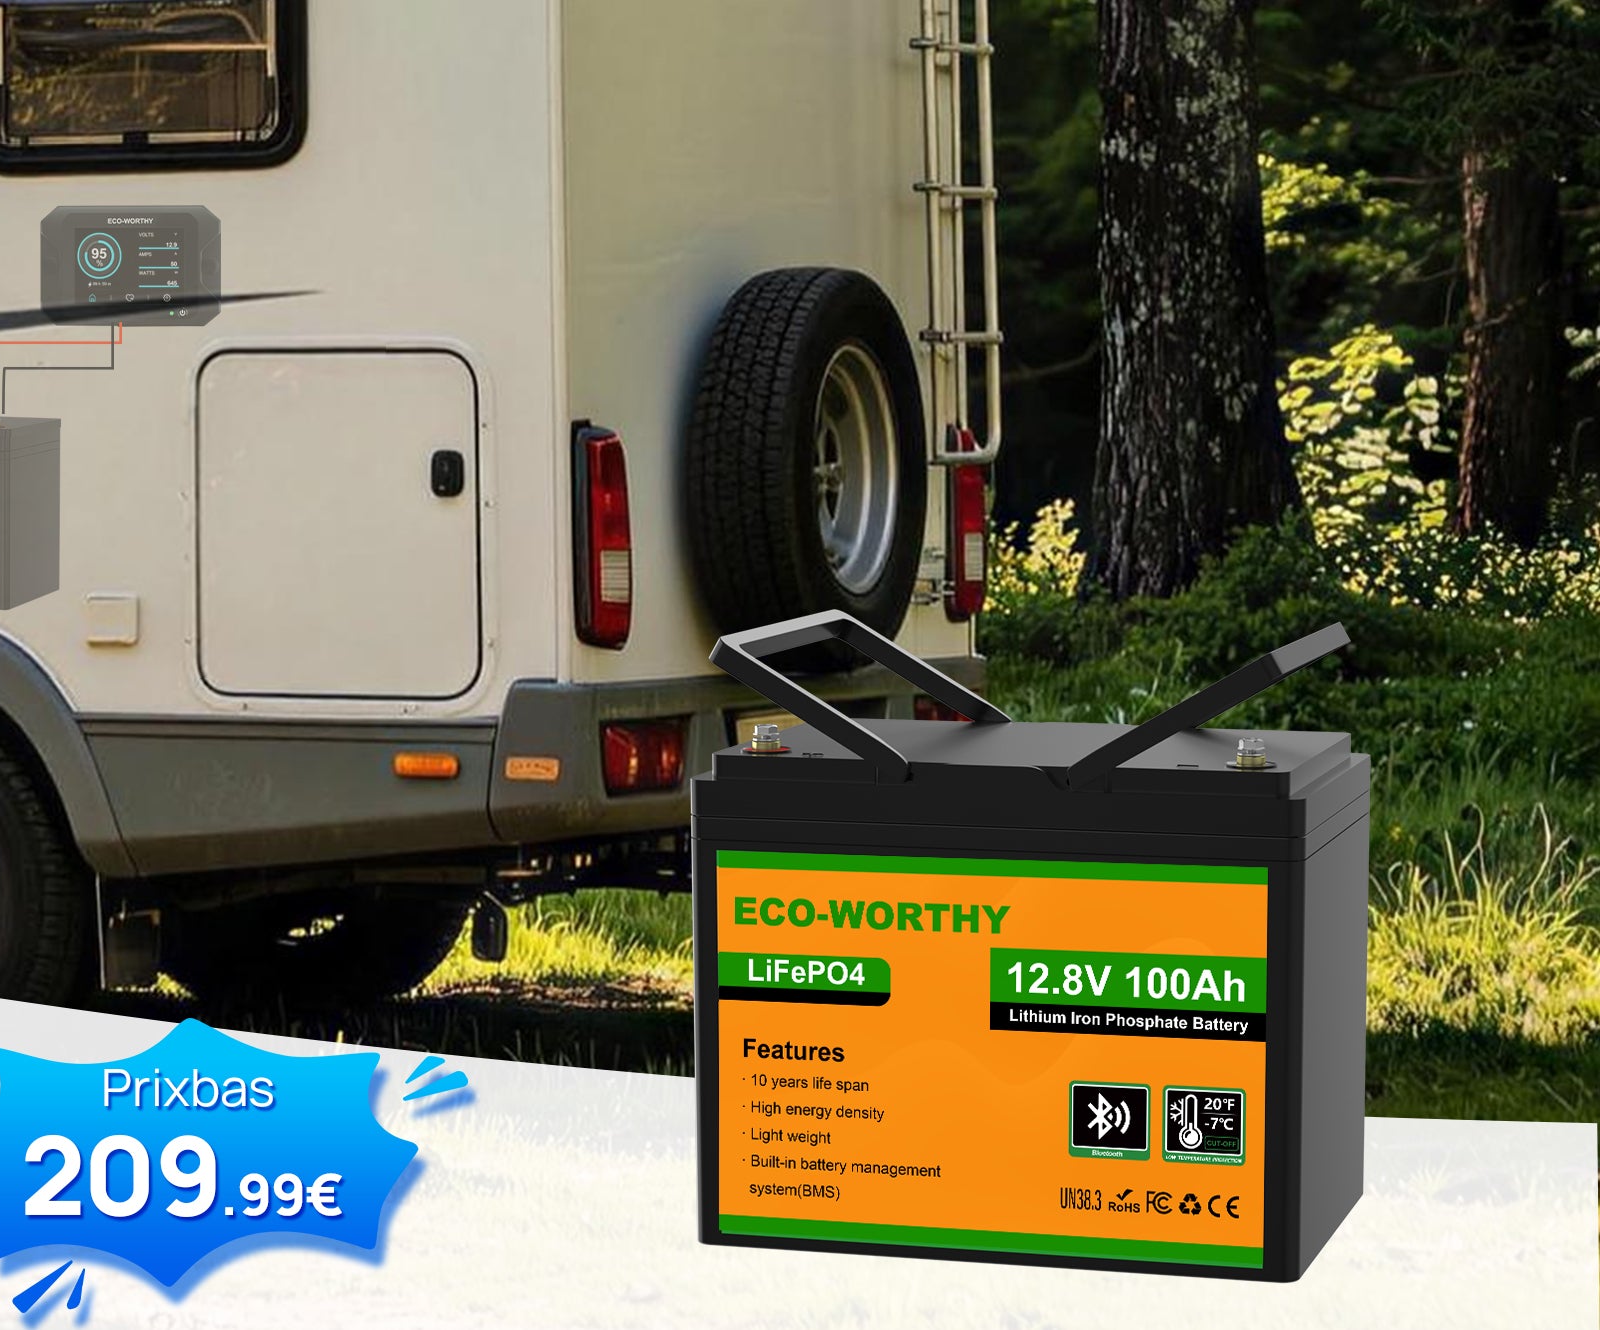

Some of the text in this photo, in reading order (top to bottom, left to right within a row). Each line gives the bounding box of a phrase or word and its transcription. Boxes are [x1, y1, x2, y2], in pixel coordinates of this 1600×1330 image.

[107, 217, 154, 225] ECO-WORTHY
[91, 247, 107, 260] 95
[734, 896, 1011, 935] ECO-WORTHY
[748, 958, 865, 986] LiFePO4
[1007, 961, 1246, 1003] 12.8V 100Ah
[1009, 1009, 1249, 1035] Lithium Iron Phosphate Battery
[743, 1037, 845, 1063] Features
[751, 1073, 869, 1093] 10 years life span
[750, 1100, 885, 1122] High energy density
[750, 1127, 831, 1147] Light weight
[1206, 1140, 1237, 1149] CUT-OFF
[1091, 1149, 1124, 1158] Bluetooth
[750, 1153, 942, 1178] Built-in battery management
[749, 1183, 841, 1202] system(BMS)
[1059, 1187, 1102, 1211] UN38.3
[1108, 1201, 1141, 1214] RoHS
